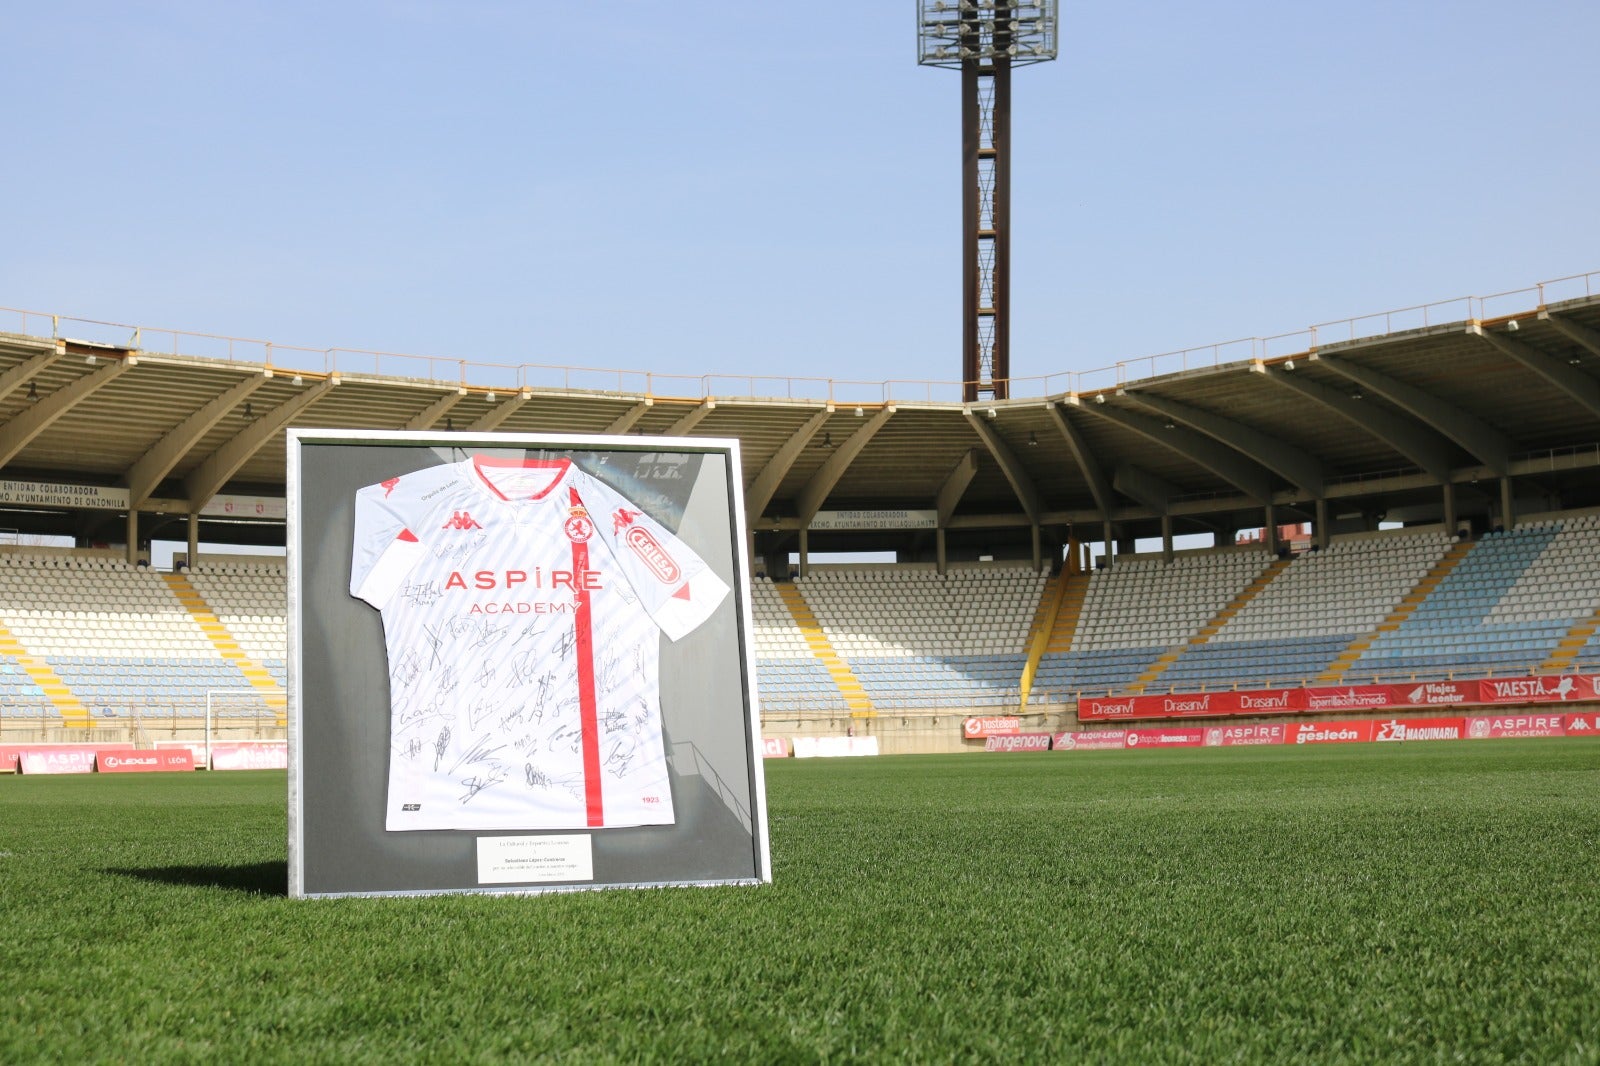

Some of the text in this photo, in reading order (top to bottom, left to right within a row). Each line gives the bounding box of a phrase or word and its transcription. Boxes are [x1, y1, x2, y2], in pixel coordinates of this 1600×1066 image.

[3, 482, 98, 495] ENTIDAD COLABORADORA
[16, 493, 71, 505] AYUNTAMIENTO
[86, 498, 125, 508] ONZONILLA
[470, 602, 581, 615] ACADEMY
[1426, 683, 1456, 694] Viajes
[1427, 692, 1464, 703] Leontur
[1406, 727, 1458, 740] MAQUINARIA
[1501, 729, 1552, 737] ACADEMY
[119, 757, 158, 765] LEXUS
